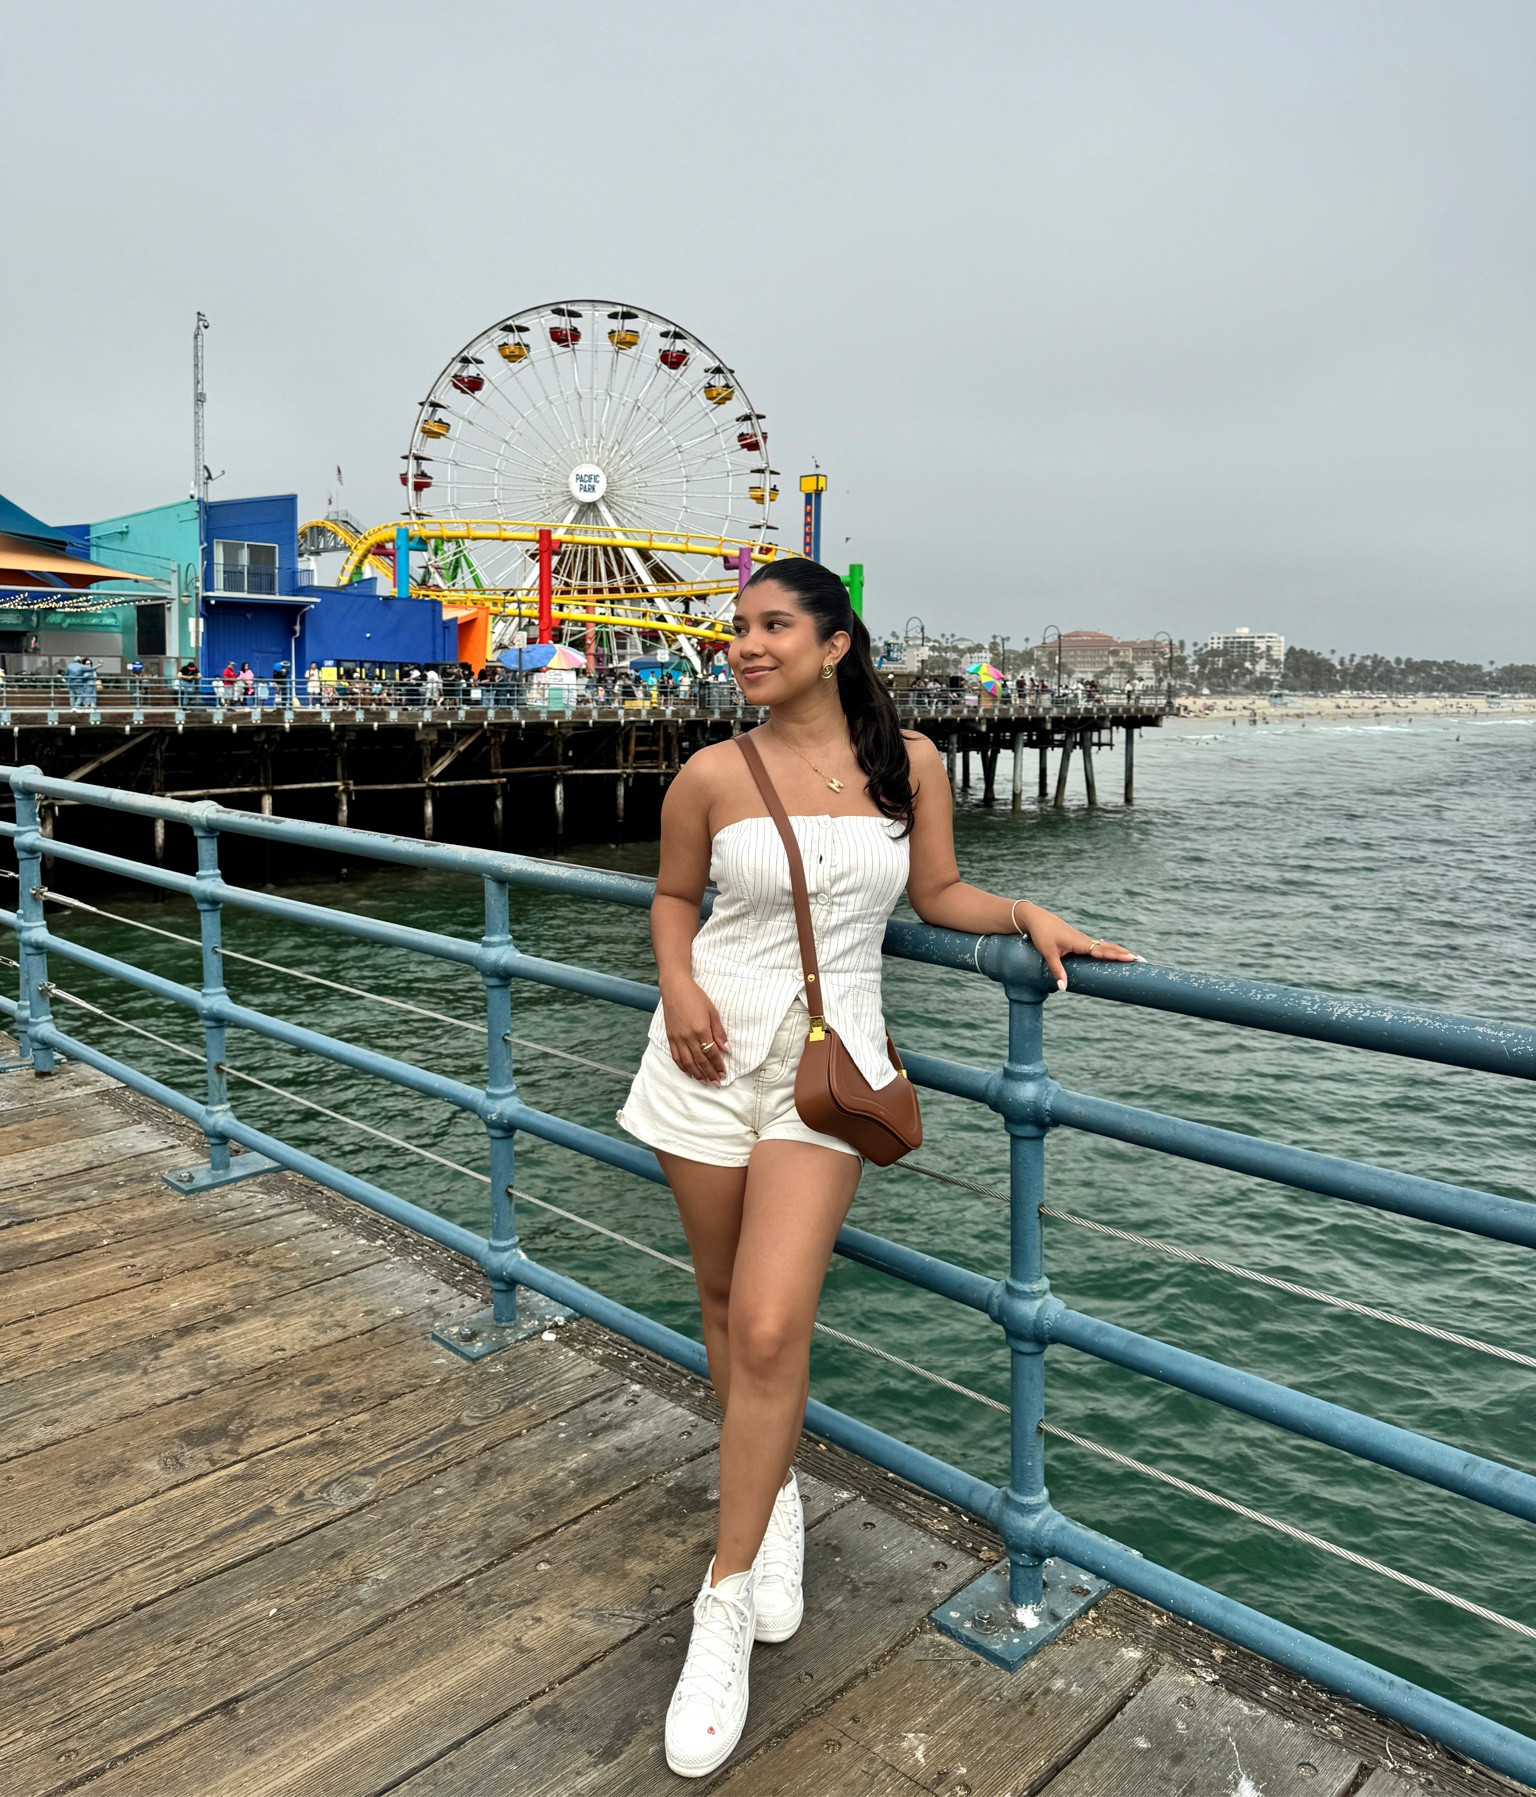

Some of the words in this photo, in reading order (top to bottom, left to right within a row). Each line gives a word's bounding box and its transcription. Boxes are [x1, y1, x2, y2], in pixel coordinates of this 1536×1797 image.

[575, 473, 600, 483] PACIFIC
[579, 484, 596, 493] PARK
[804, 505, 812, 554] PACIF
